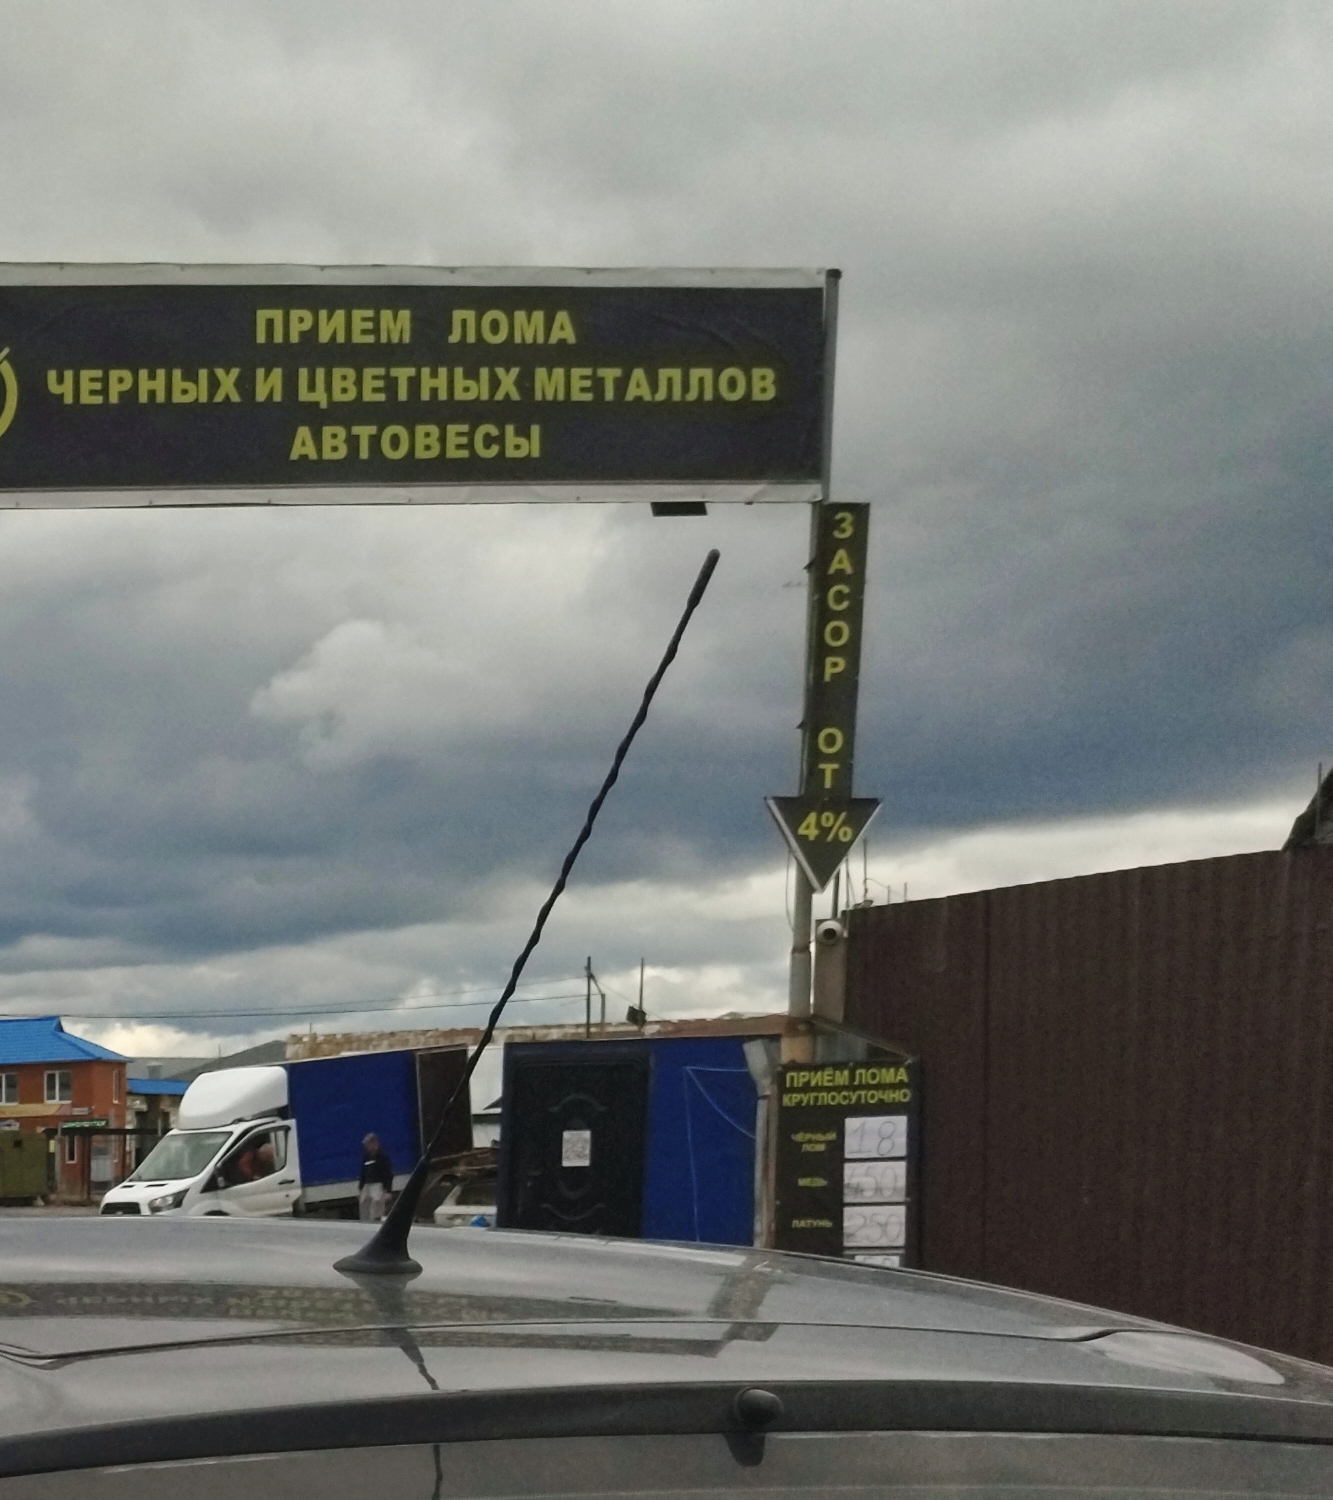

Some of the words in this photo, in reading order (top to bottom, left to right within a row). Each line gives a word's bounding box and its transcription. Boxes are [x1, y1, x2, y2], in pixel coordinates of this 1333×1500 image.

[255, 308, 412, 344] ПРИЕМ
[448, 309, 578, 344] ЛОМА
[46, 367, 242, 405] ЧЕРНЫХ
[255, 367, 283, 402] И
[297, 366, 522, 409] ЦВЕТНЫХ
[534, 366, 777, 402] МЕТАЛЛОВ
[288, 424, 542, 461] АВТОВЕСЫ
[823, 511, 856, 683] ЗАСОР
[817, 727, 845, 790] ОТ
[797, 811, 853, 844] 4%
[854, 1067, 909, 1086] ЛОМА
[782, 1089, 912, 1107] КРУГЛОСУТОЧНО
